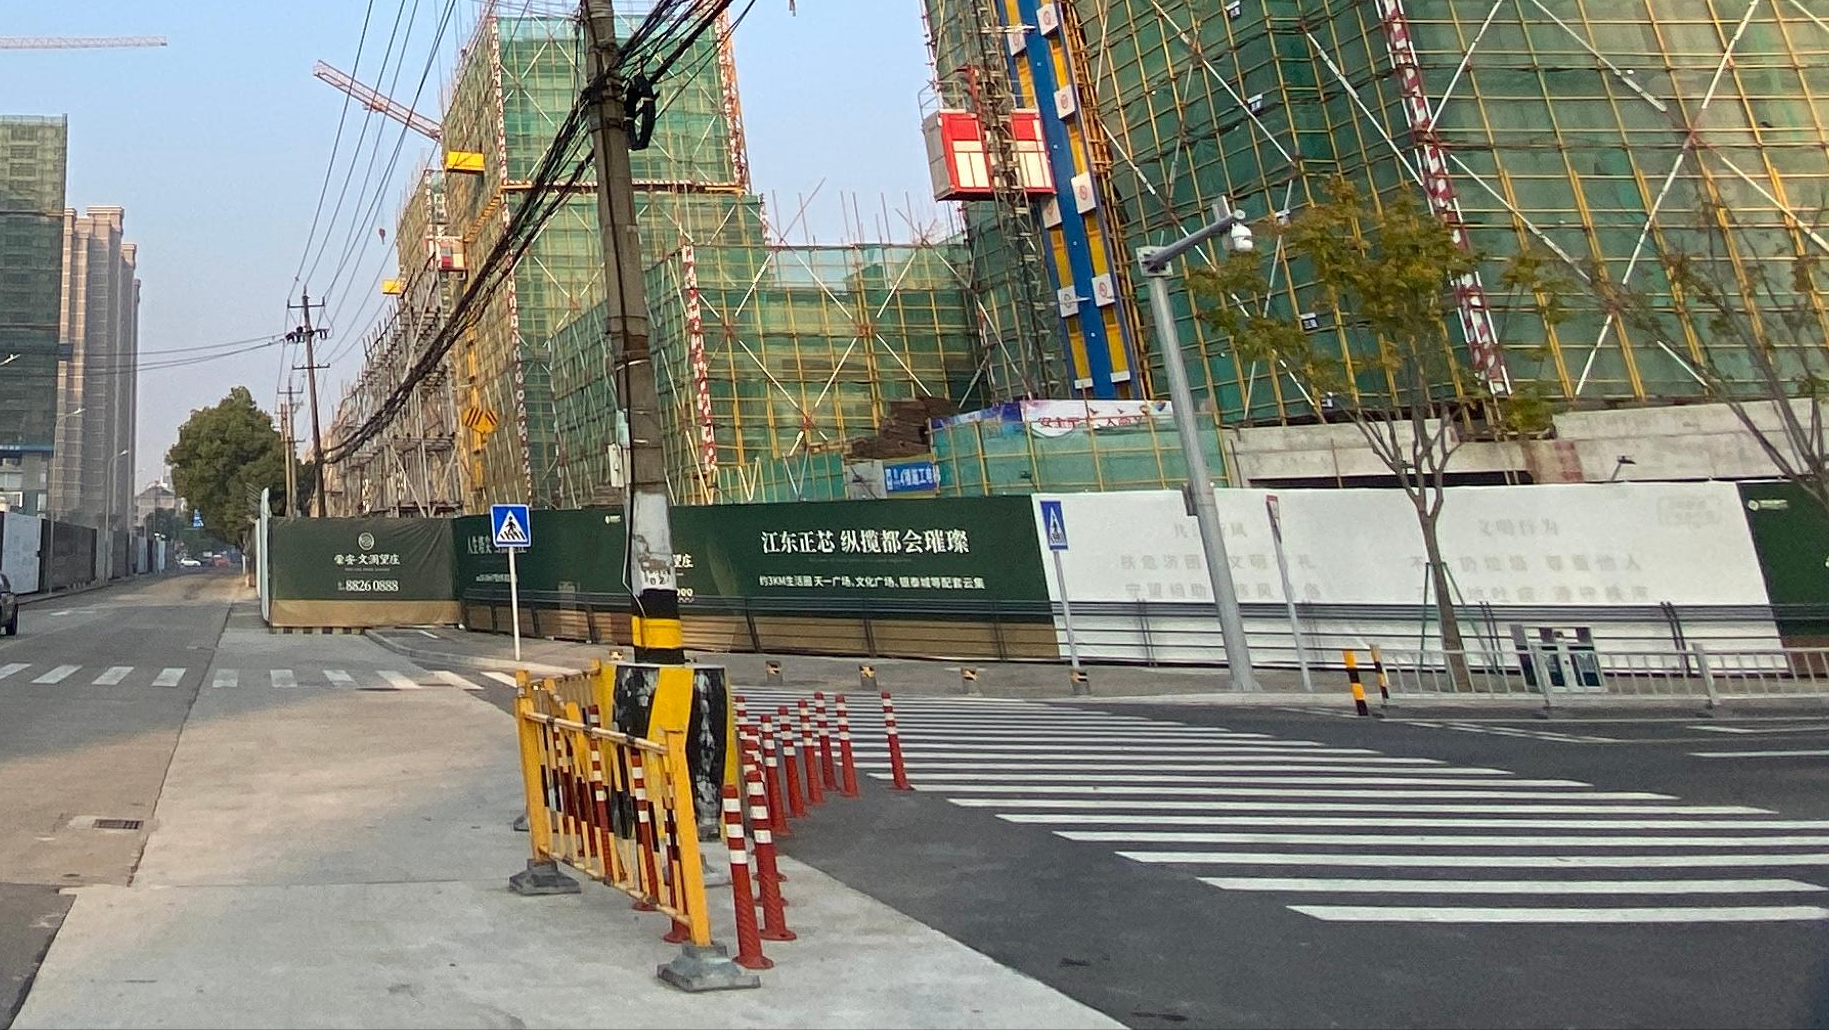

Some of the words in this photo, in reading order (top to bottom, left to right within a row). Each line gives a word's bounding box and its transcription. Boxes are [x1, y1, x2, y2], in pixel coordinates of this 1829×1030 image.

[760, 530, 836, 554] 江东正芯
[840, 528, 970, 555] 纵揽都会璀璨
[1228, 553, 1316, 570] 文明礼
[346, 579, 371, 591] 8826
[372, 579, 399, 592] 0888
[1234, 582, 1322, 600] 移风俗
